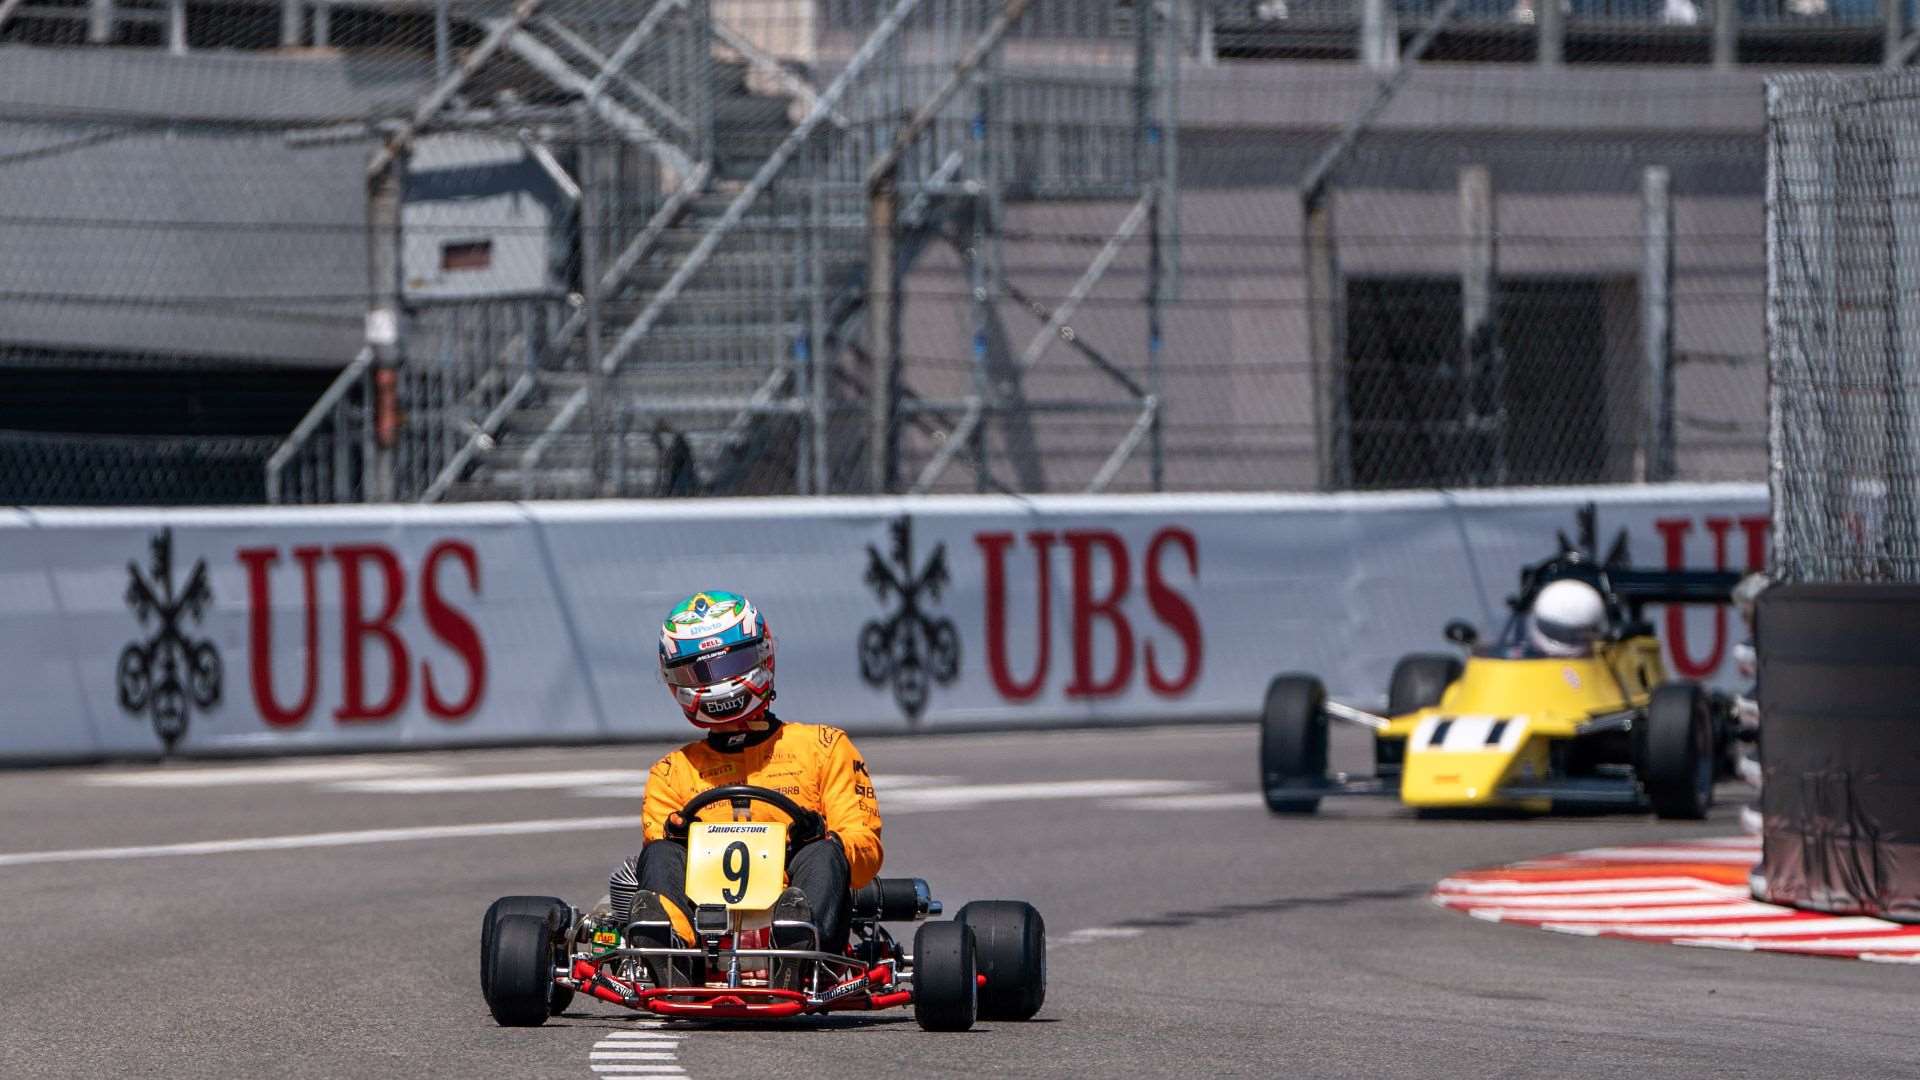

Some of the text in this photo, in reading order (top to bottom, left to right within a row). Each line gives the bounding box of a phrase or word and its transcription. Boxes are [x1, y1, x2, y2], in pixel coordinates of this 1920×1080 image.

[236, 538, 489, 727] UBS
[973, 525, 1205, 705] UBS
[700, 639, 720, 649] BELL
[707, 695, 744, 713] Ebury
[707, 825, 768, 833] BRIDGESTONE
[722, 840, 750, 904] 9
